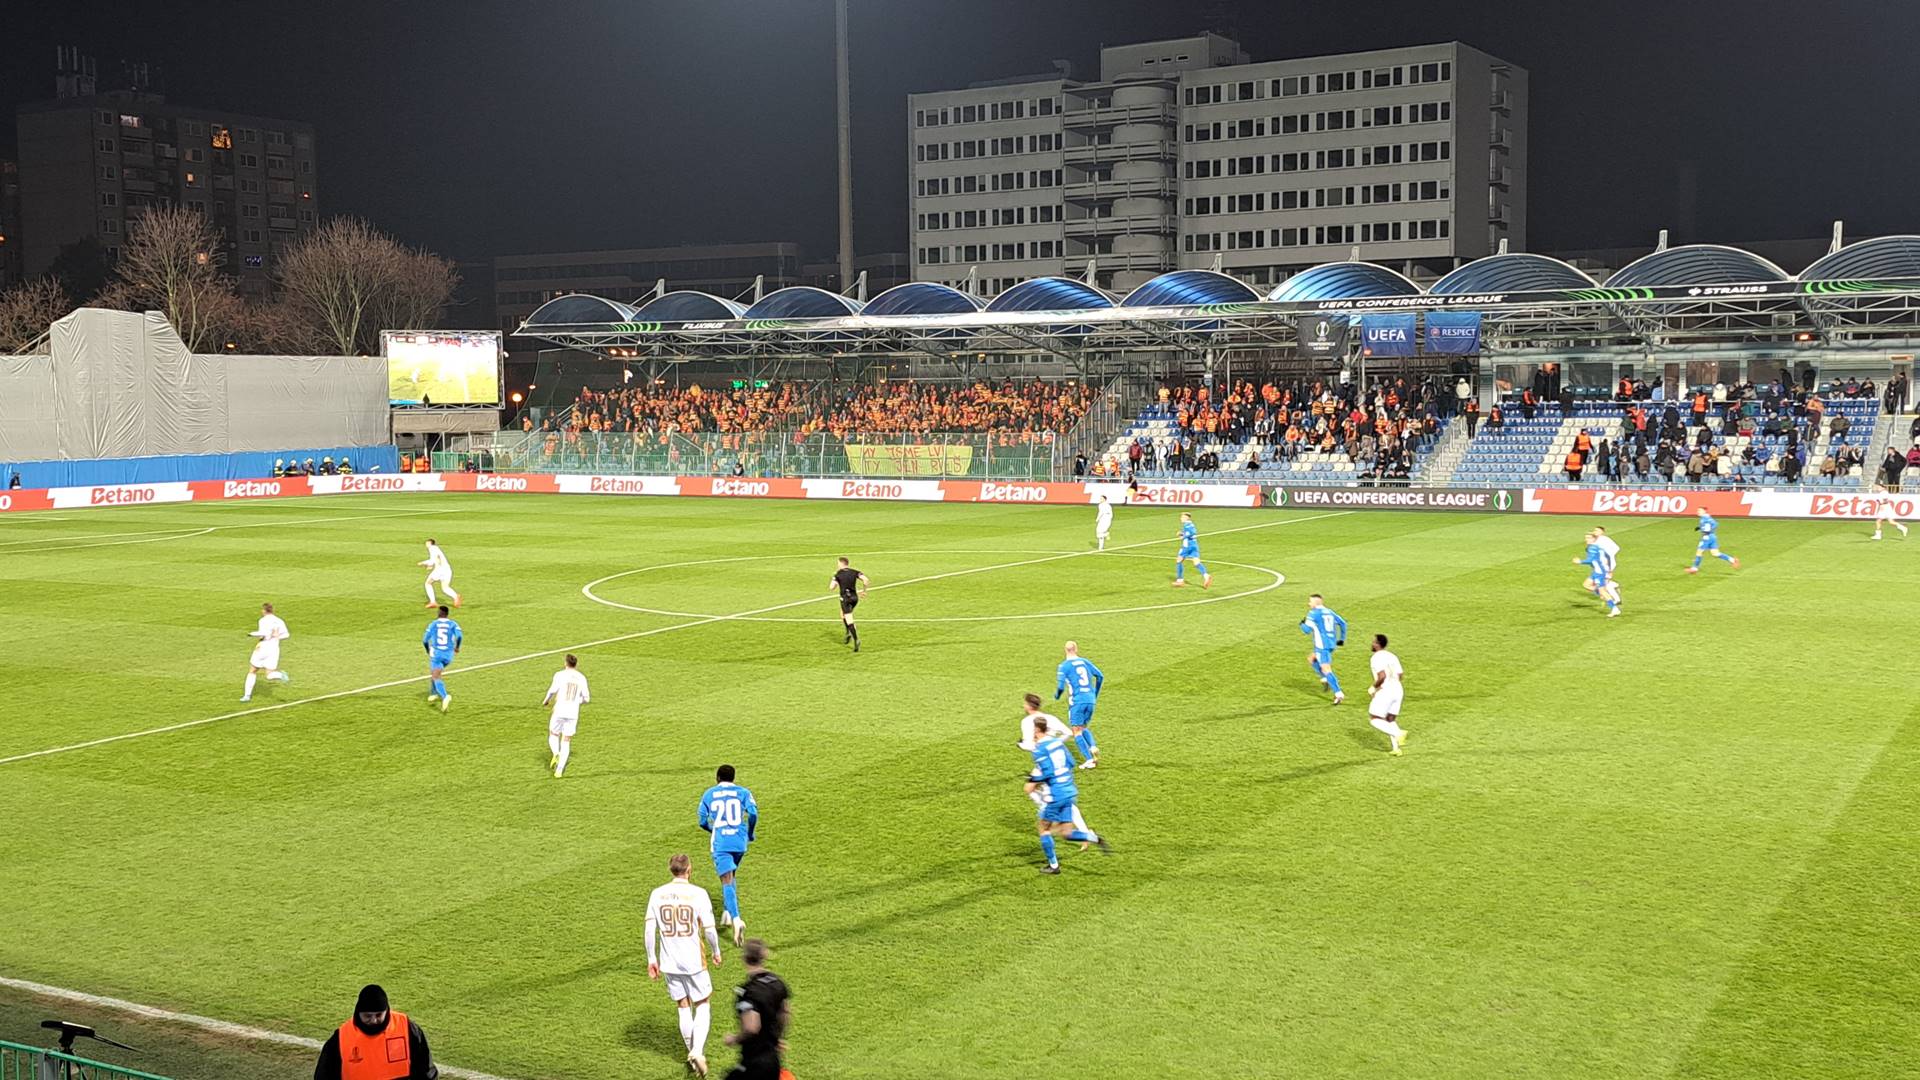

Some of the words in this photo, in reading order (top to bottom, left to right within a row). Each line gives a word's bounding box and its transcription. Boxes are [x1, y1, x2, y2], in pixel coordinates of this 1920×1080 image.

[1703, 285, 1767, 295] STRAUSS
[1318, 301, 1353, 309] UEFA
[1355, 297, 1444, 308] CONFERENCE
[1447, 295, 1503, 304] LEAGUE
[1368, 328, 1407, 341] UEFA
[1441, 328, 1476, 337] RESPECT
[224, 480, 281, 498] Betano
[341, 475, 404, 491] Betano
[476, 474, 527, 490] Betano
[590, 477, 644, 493] Betano
[712, 478, 769, 496] Betano
[842, 481, 902, 498] Betano
[91, 487, 154, 505] Betano
[980, 482, 1047, 501] Betano
[1293, 491, 1331, 504] UEFA
[1332, 491, 1425, 506] CONFERENCE
[1428, 493, 1485, 507] LEAGUE
[1592, 491, 1687, 513] Betano
[437, 628, 448, 645] 5
[1075, 666, 1089, 687] 3
[711, 799, 742, 828] 20
[660, 904, 695, 938] 99
